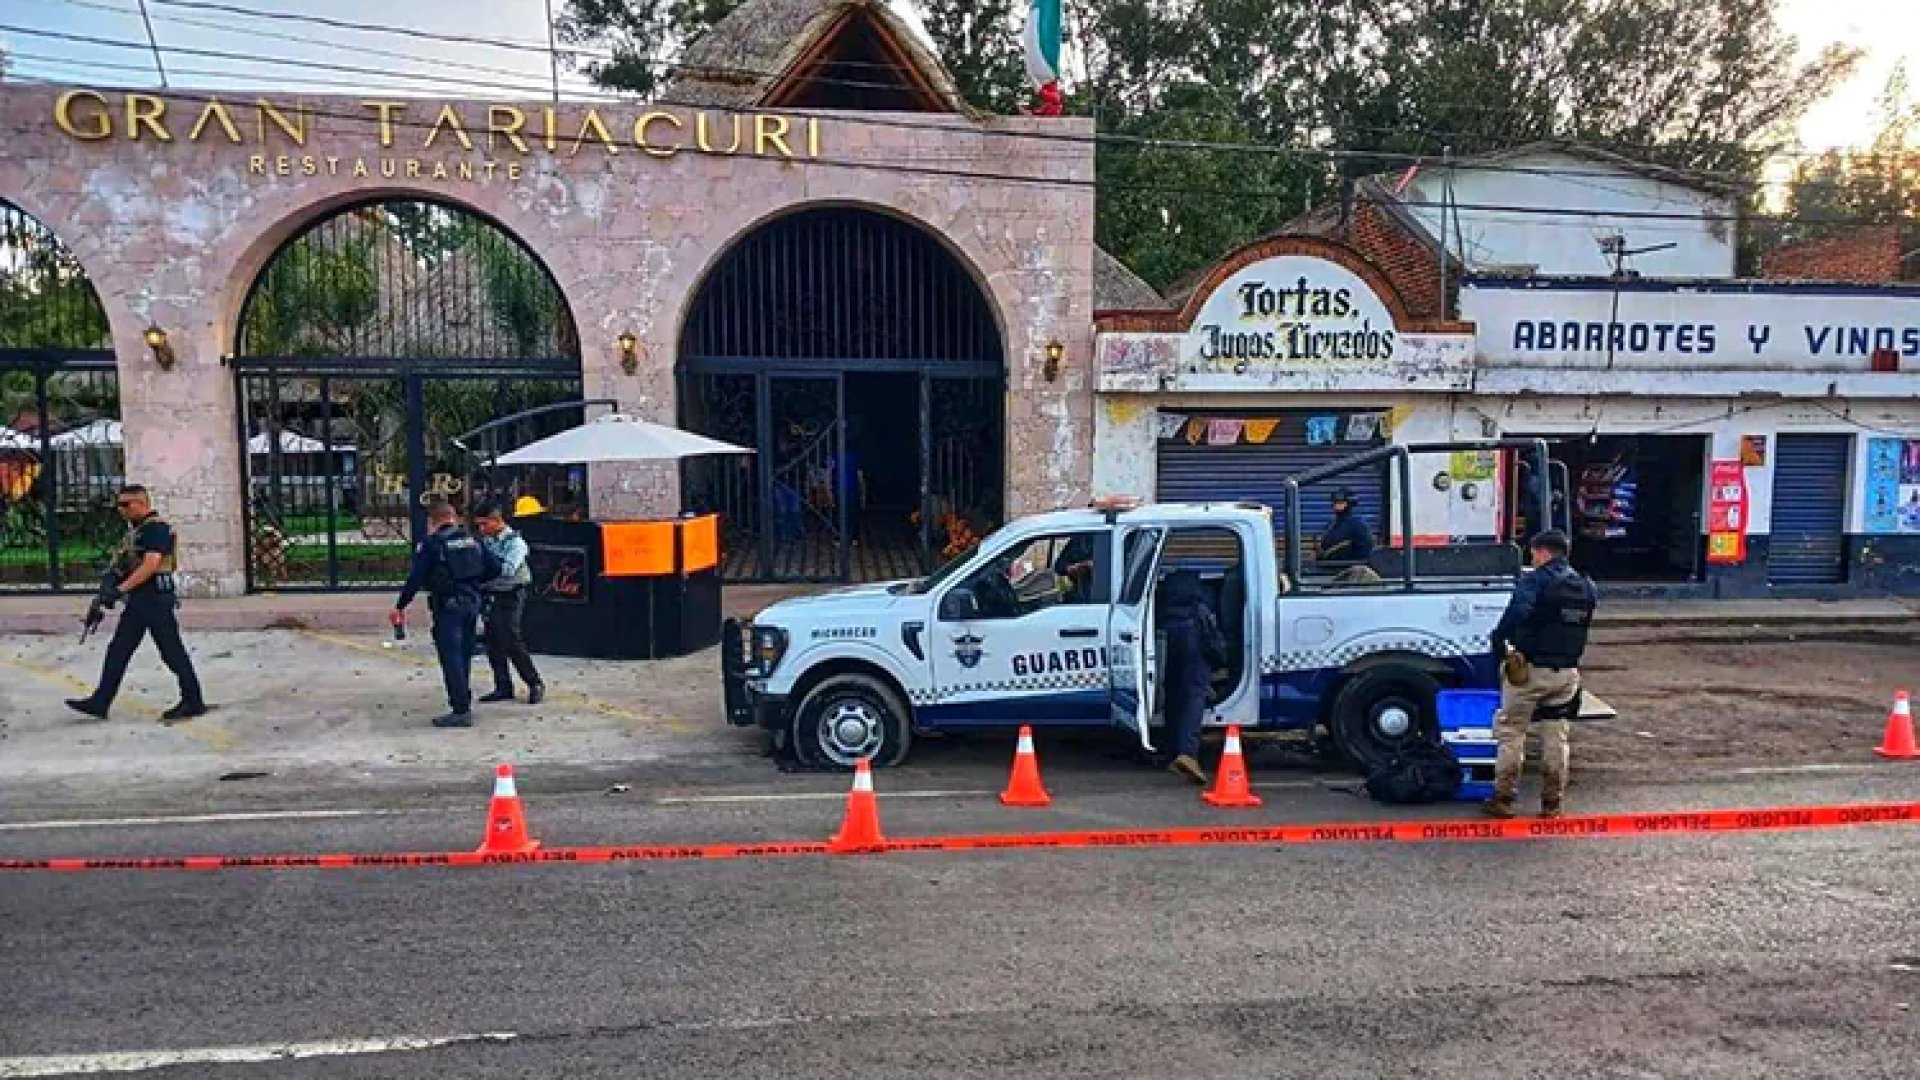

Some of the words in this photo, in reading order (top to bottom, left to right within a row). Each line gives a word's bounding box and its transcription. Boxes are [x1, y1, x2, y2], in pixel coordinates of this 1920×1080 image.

[55, 88, 311, 147] GRAN
[361, 101, 820, 160] TARIACURI
[248, 154, 523, 181] RESTAURANTE
[1514, 320, 1716, 354] ABARROTES
[1748, 324, 1771, 354] Y
[1805, 325, 1920, 357] VINOS
[1529, 817, 1609, 835] PELIGRO
[1632, 814, 1711, 832] PELIGRO
[1736, 809, 1812, 828] PELIGRO
[1836, 804, 1911, 824] PELIGRO
